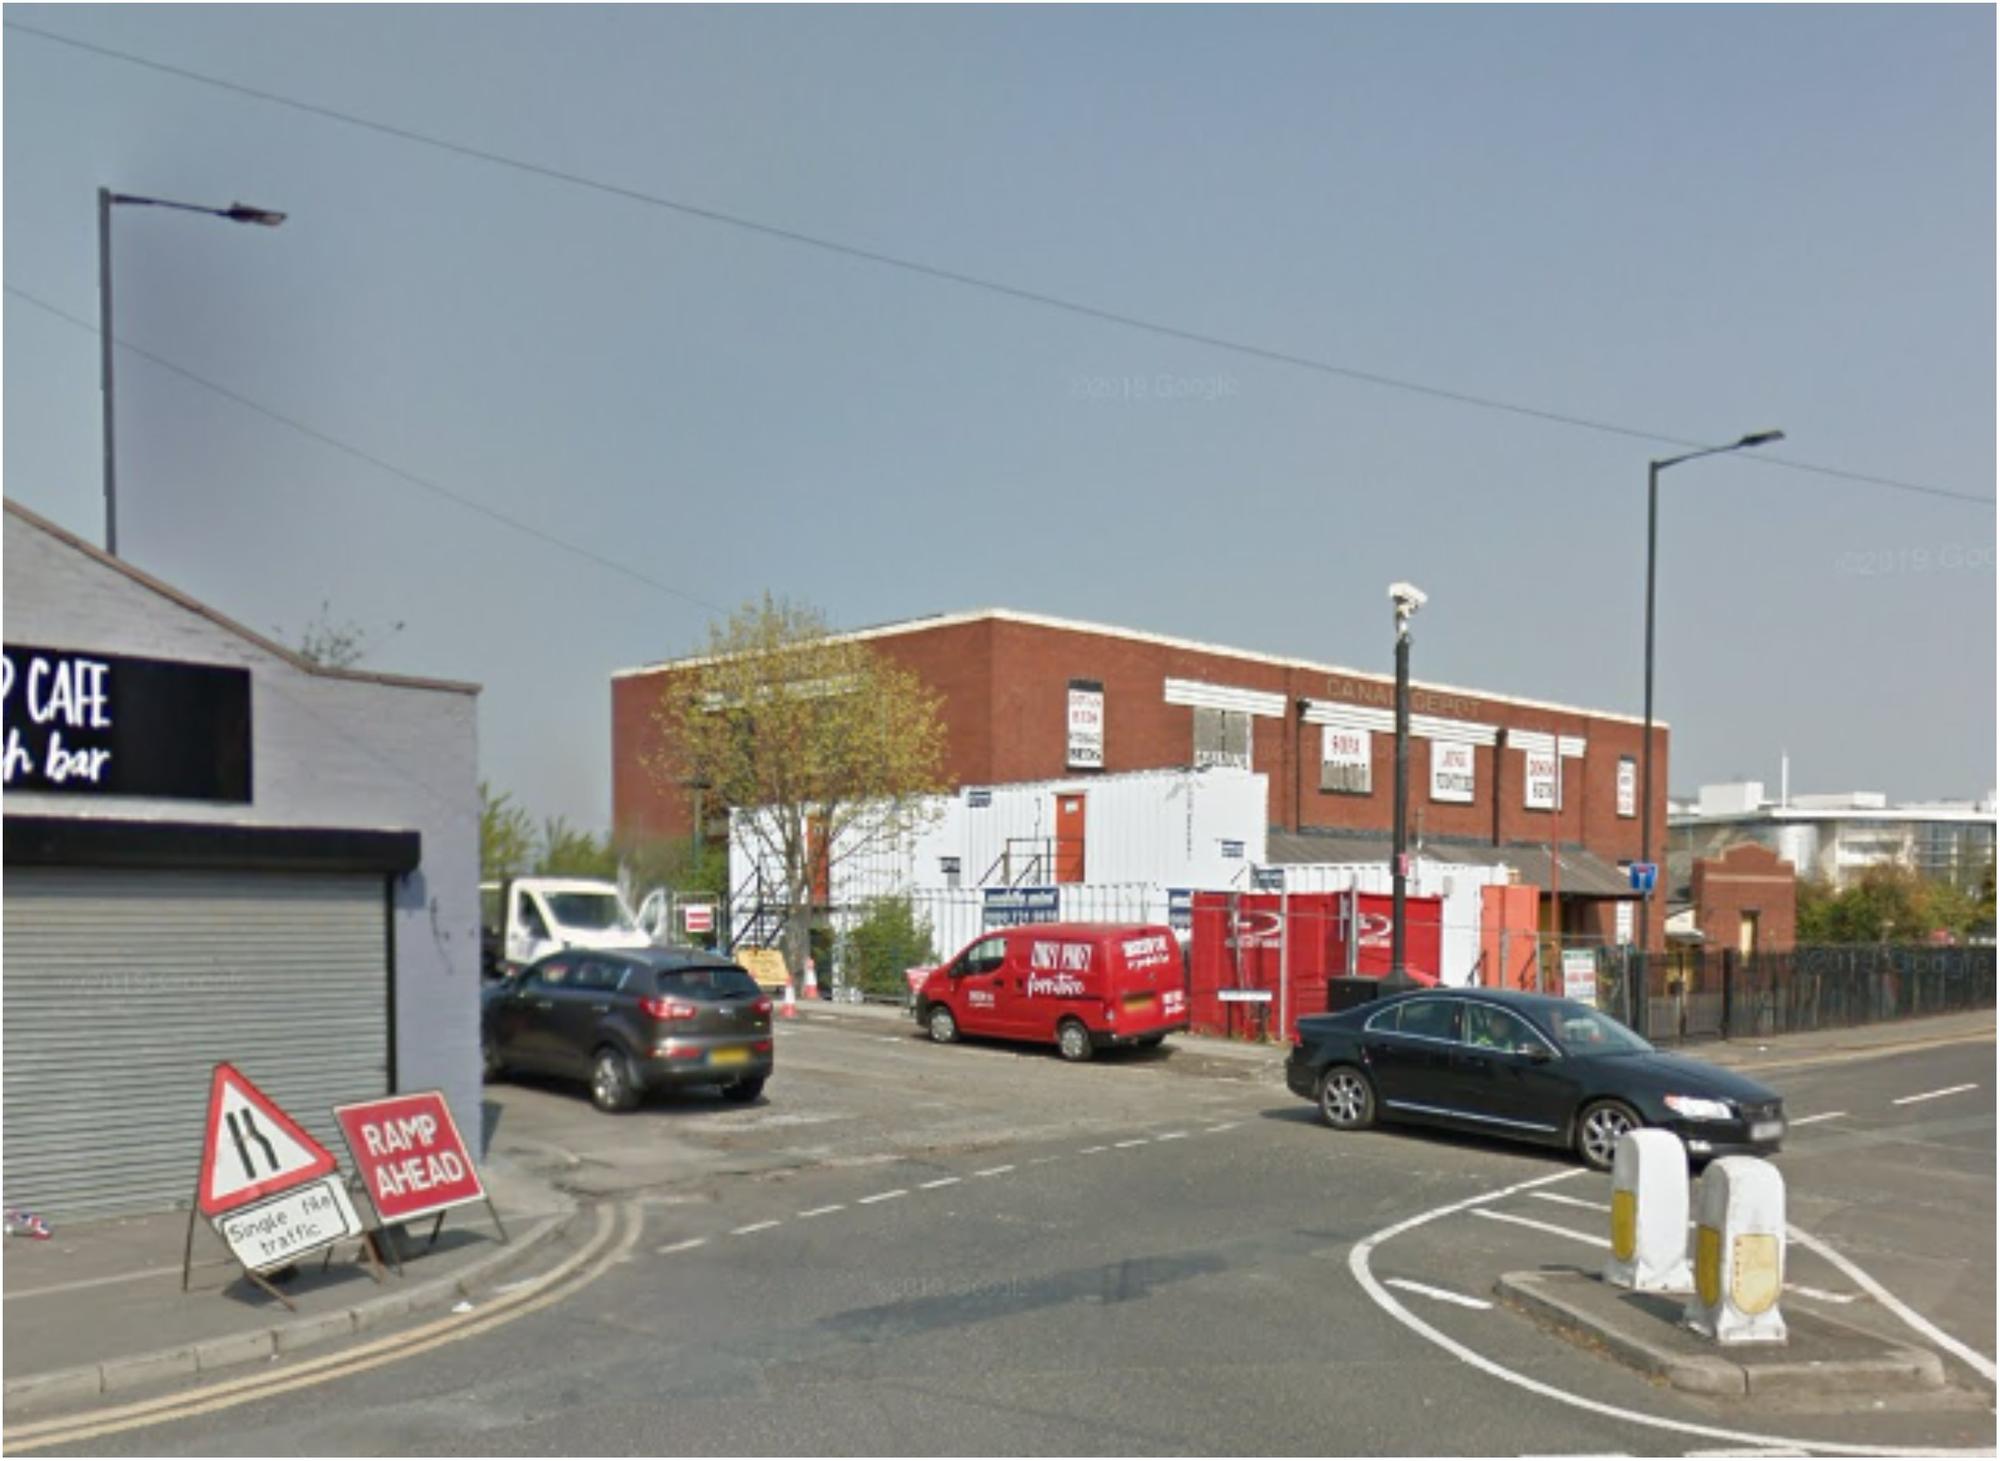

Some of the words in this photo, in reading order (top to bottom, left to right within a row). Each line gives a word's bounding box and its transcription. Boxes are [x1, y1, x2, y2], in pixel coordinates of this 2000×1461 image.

[27, 657, 111, 727] CAFE
[1413, 689, 1481, 717] DEPOT
[45, 731, 111, 782] bar
[361, 1114, 438, 1157] RAMP
[375, 1150, 466, 1200] AHEAD
[228, 1210, 288, 1243] Single
[302, 1193, 333, 1215] file
[260, 1221, 321, 1254] traffic
